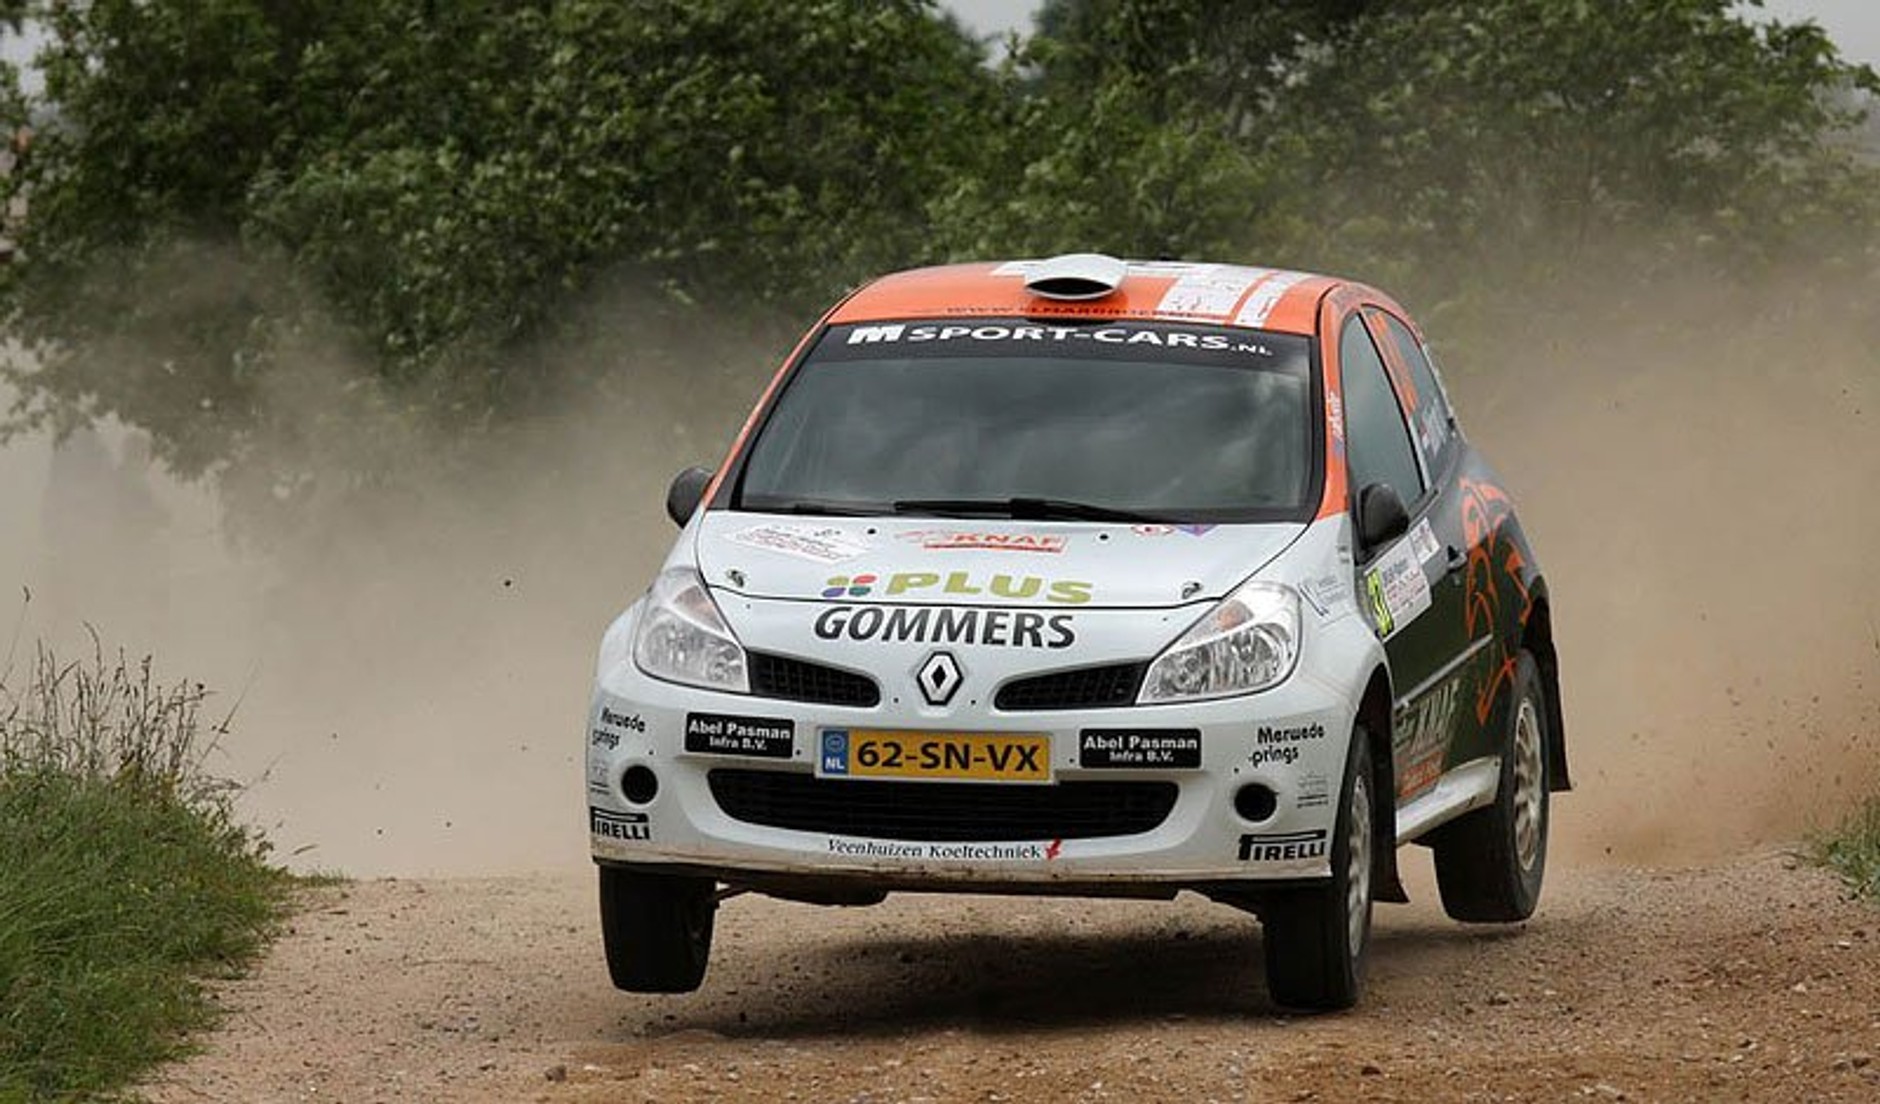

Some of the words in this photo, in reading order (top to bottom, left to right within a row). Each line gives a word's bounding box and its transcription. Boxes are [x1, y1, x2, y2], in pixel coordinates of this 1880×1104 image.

[953, 533, 1062, 546] KNAF
[885, 571, 1093, 604] PLUS
[814, 606, 1076, 648] GOMMERS
[689, 720, 723, 734] Abel
[726, 722, 791, 739] Pasman
[1257, 723, 1325, 744] Merwede
[709, 735, 739, 748] Infra
[742, 737, 767, 750] B.V.
[1083, 735, 1123, 750] Abel
[1128, 735, 1197, 750] Pasman
[825, 757, 845, 770] NL
[857, 741, 1040, 772] 62-SN-VX
[1109, 750, 1143, 762] Infra
[1147, 750, 1174, 762] B.V.
[590, 806, 650, 839] PIRELLI
[827, 839, 923, 858] Veenhuizen
[929, 844, 1041, 859] Koeltechniek
[1238, 829, 1327, 861] PIRELLI
